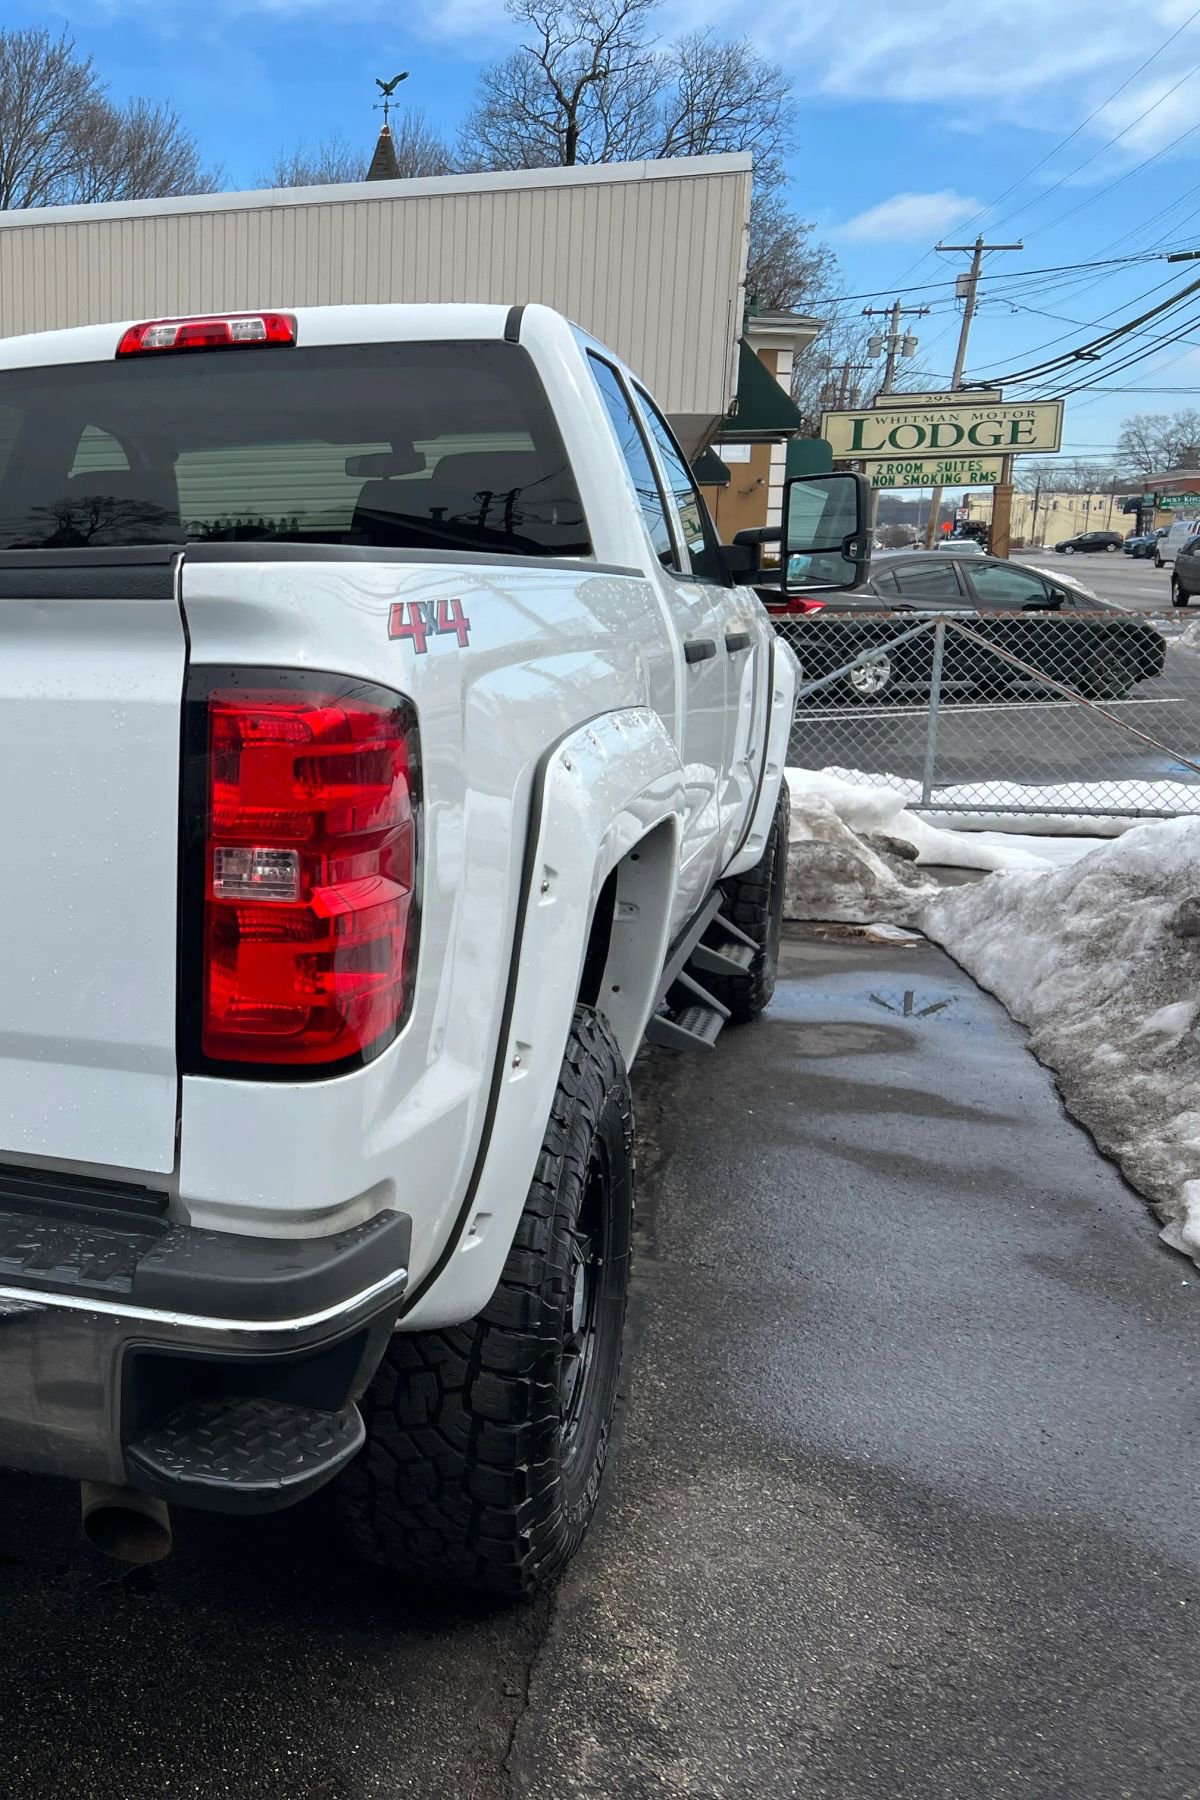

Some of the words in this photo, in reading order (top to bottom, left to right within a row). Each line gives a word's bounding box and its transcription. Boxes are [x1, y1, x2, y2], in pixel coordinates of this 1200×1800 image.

[924, 395, 952, 403] 295
[875, 413, 960, 425] WHITMAN
[971, 410, 1036, 421] MOTOR
[846, 418, 1037, 450] LODGE
[936, 460, 983, 473] SUITES
[872, 475, 896, 486] NON
[903, 473, 961, 485] SMOKING
[970, 471, 997, 482] RMS
